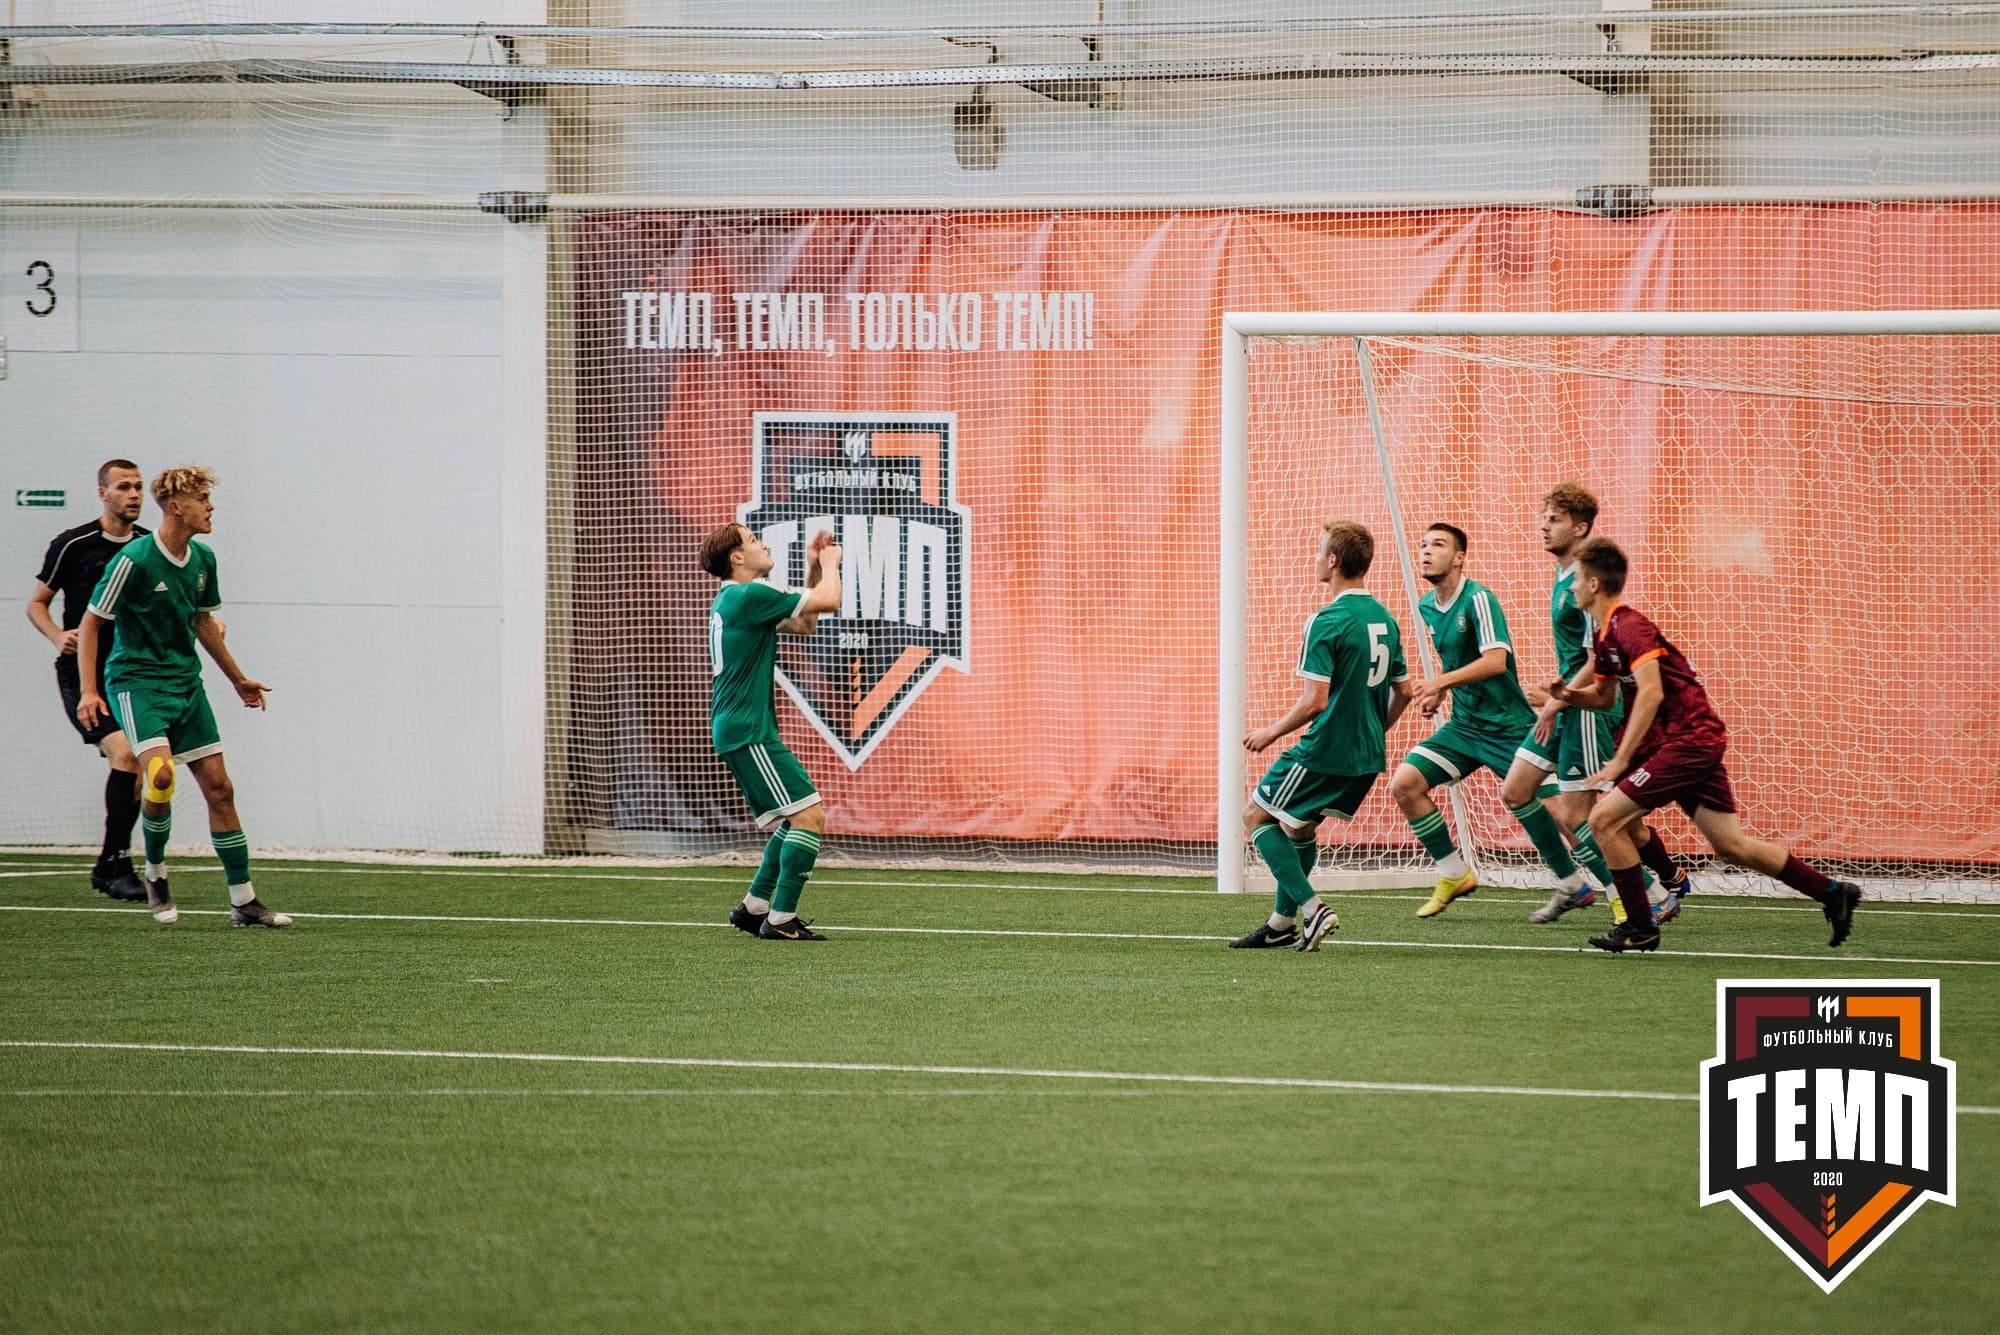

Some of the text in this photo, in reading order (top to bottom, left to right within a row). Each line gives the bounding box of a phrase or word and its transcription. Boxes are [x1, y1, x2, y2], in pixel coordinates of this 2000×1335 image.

[26, 260, 56, 317] 3
[622, 291, 1094, 357] ТЕМП, ТЕМП, ТОЛЬКО ТЕМП!
[882, 470, 916, 491] КЛУБ
[838, 632, 869, 649] 2020
[1366, 622, 1390, 688] 5
